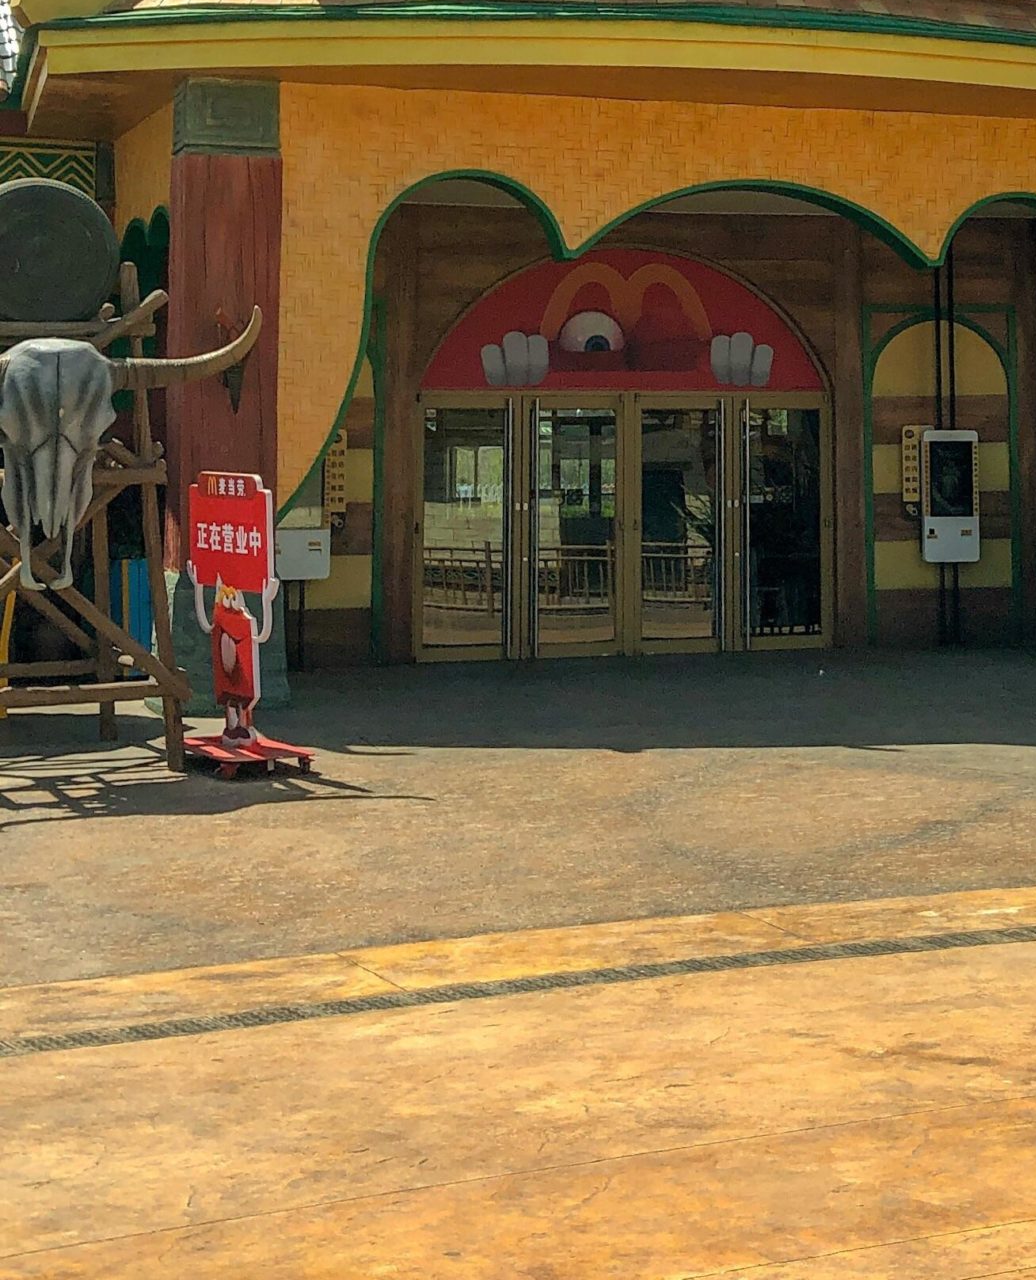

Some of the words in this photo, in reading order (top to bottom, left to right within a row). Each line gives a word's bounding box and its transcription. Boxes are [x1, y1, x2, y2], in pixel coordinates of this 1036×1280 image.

[218, 477, 245, 496] 麦当劳
[197, 522, 262, 557] 正在营业中
